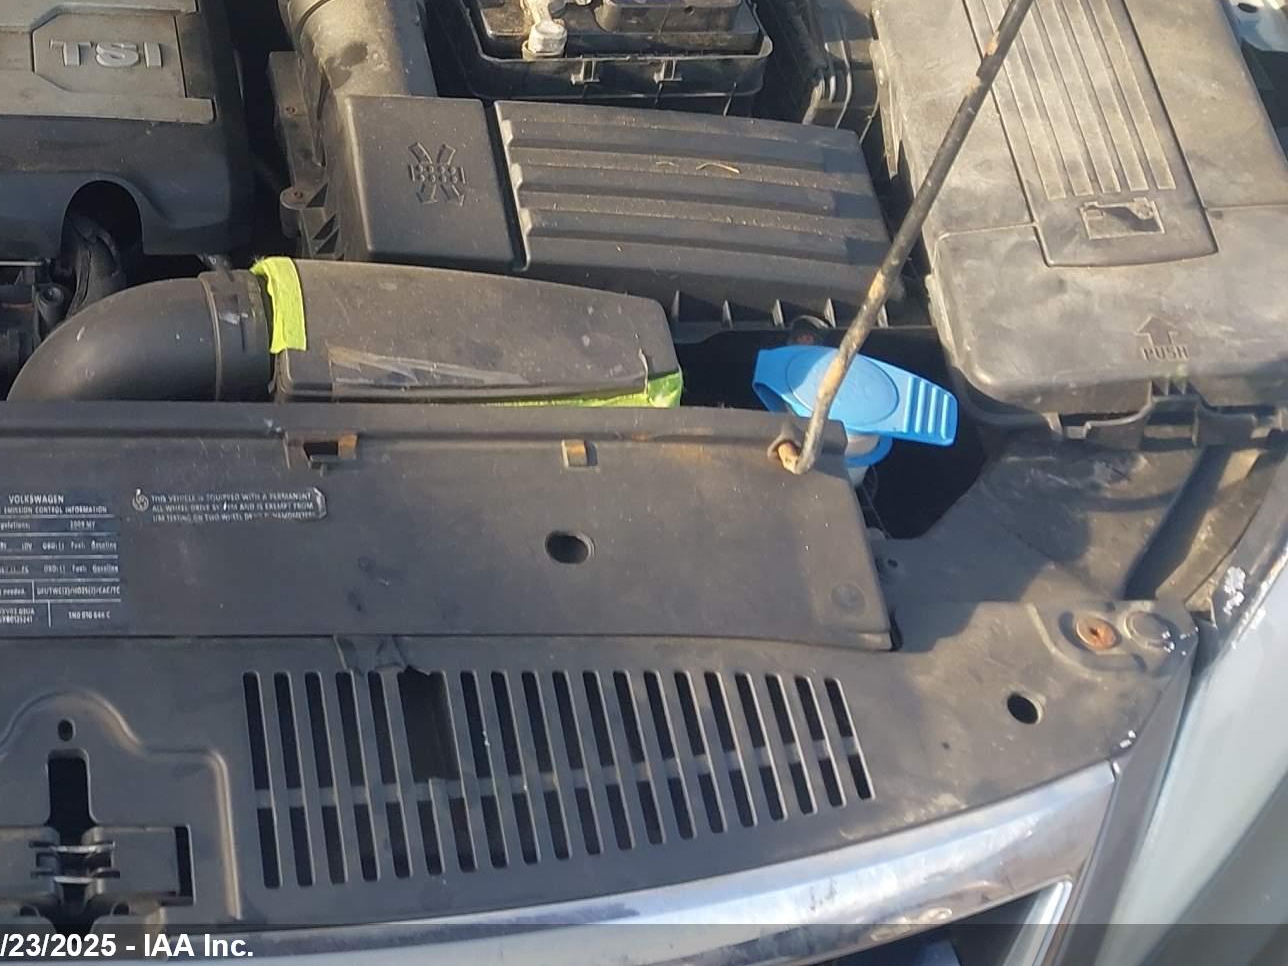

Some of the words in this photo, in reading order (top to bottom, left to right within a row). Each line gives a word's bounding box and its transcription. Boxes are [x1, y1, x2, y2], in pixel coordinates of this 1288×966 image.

[49, 41, 162, 68] TSI
[1142, 345, 1189, 362] PUSH
[8, 495, 64, 504] VOLKSWAGEN
[3, 506, 33, 514] EMISSION
[34, 506, 63, 514] CONTROL
[64, 506, 108, 514] INFORMATION
[152, 504, 164, 512] ALL
